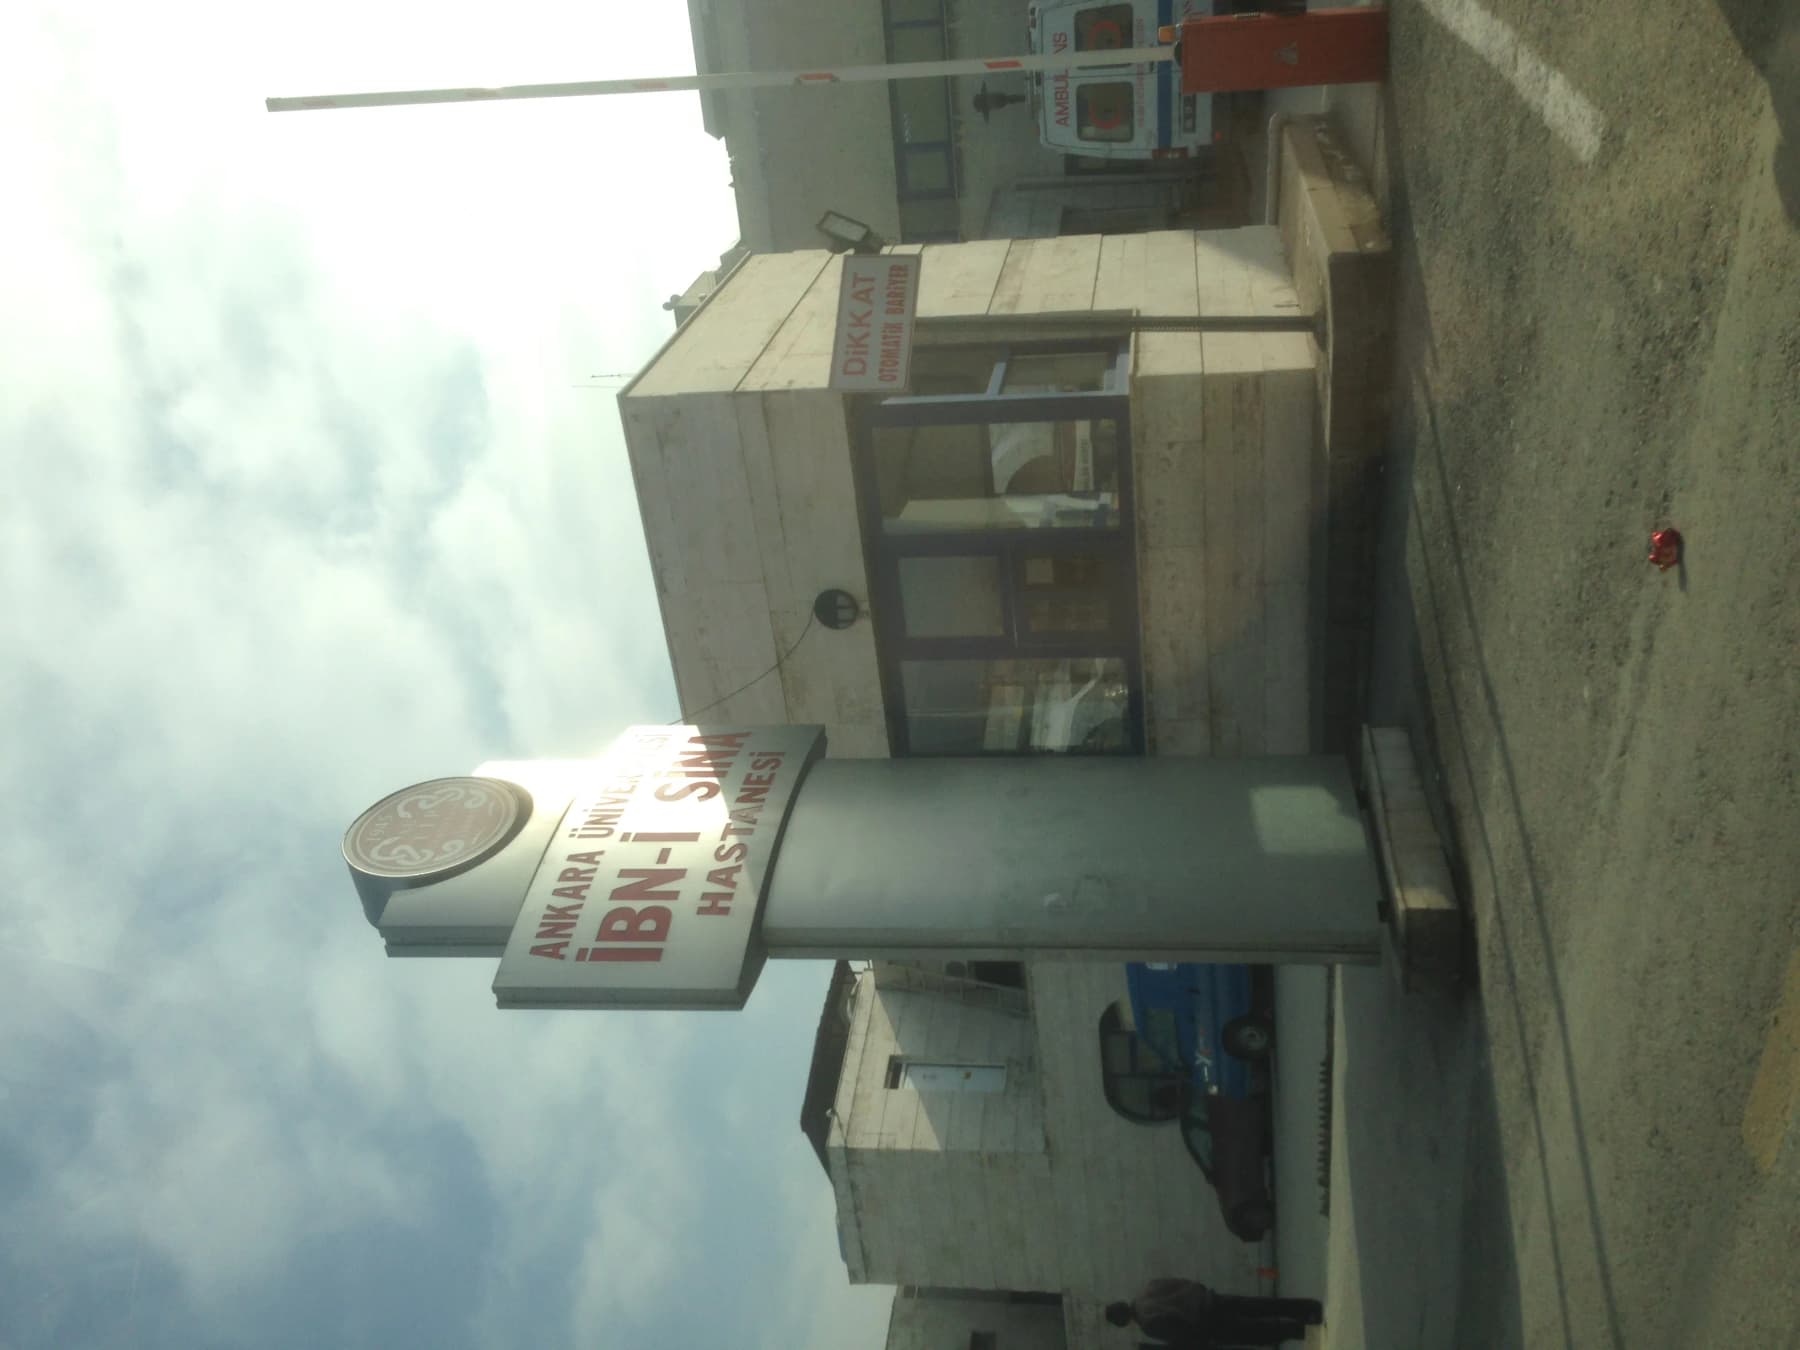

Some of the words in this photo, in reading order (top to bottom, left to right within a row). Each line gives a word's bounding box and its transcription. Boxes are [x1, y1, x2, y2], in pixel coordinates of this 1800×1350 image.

[1053, 32, 1070, 127] AMBULNS
[576, 832, 701, 962] İBN-İ
[653, 731, 752, 802] SİNA
[697, 751, 785, 916] HASTANESİ
[529, 850, 605, 960] ANKARA
